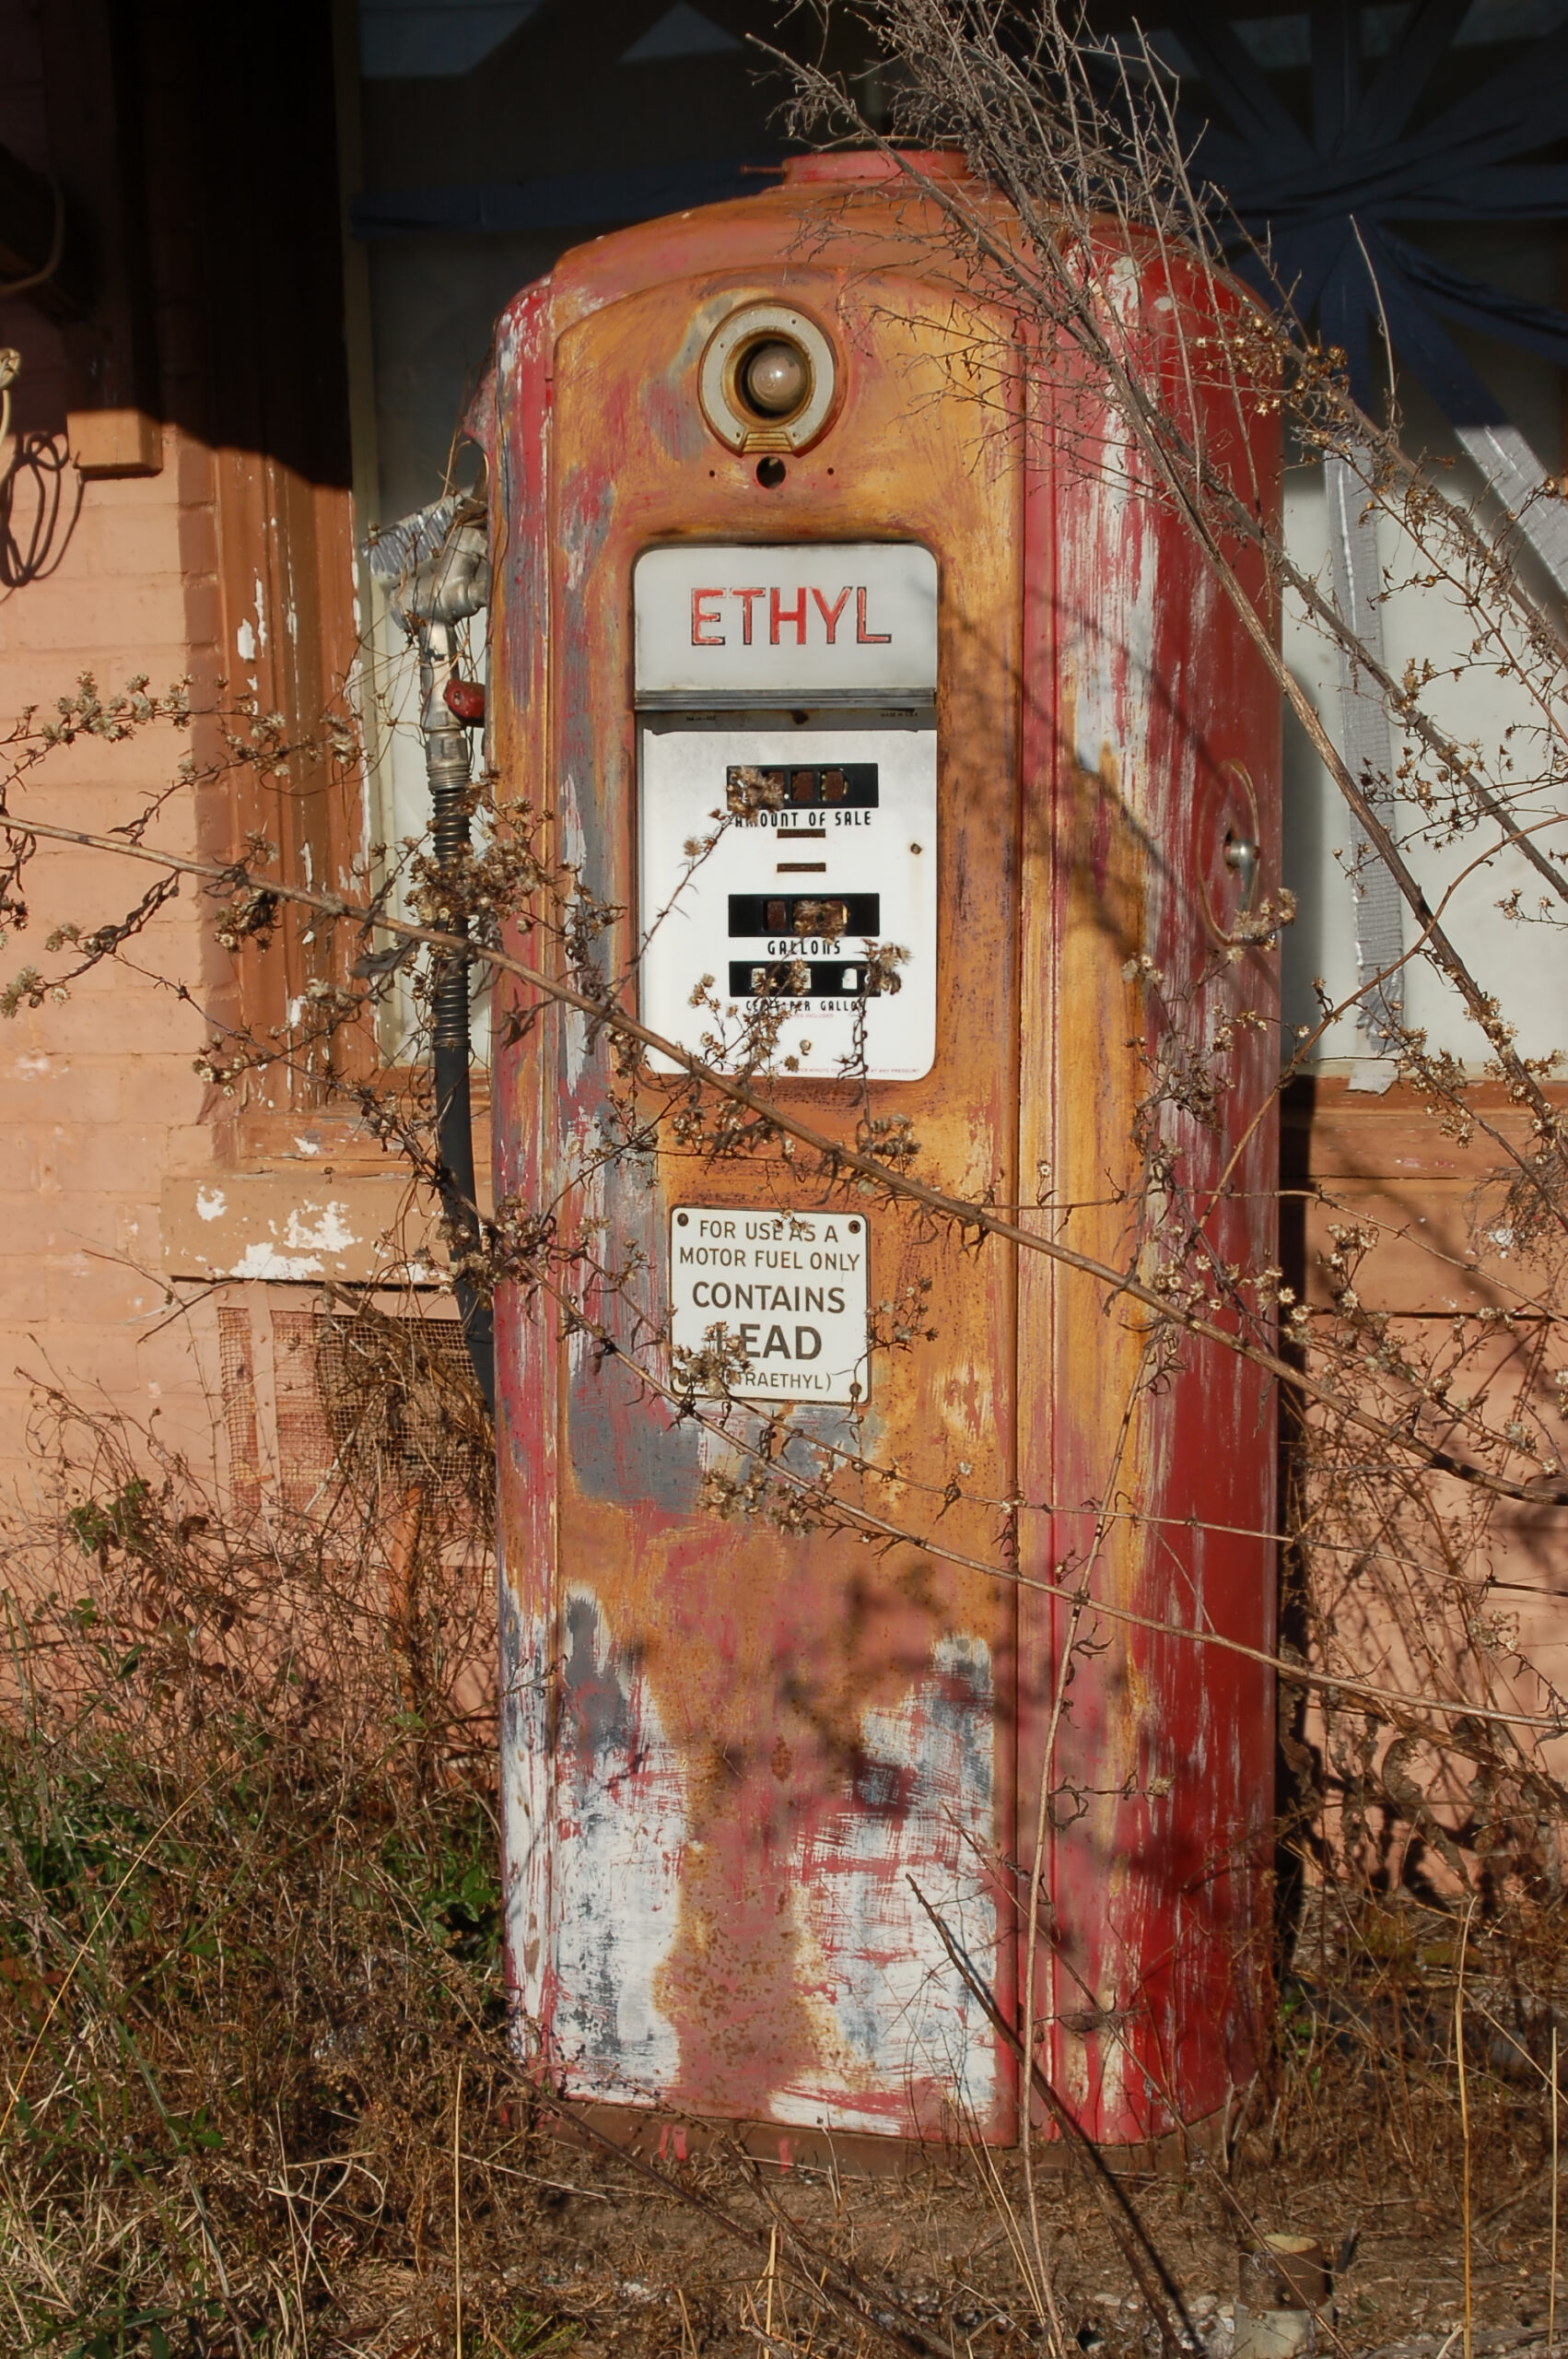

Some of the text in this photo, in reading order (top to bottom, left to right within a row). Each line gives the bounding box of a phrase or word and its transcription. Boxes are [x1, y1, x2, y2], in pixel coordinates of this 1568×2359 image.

[691, 586, 893, 645] ETHYL
[734, 810, 872, 827] AOUNT OF SALE
[766, 940, 841, 956] GALLONS
[699, 1219, 838, 1243] FOR USE AS A
[679, 1246, 860, 1272] MOTOR FUEL ONLY
[692, 1280, 846, 1314] CONTAINS
[736, 1370, 832, 1393] RAETHYL)
